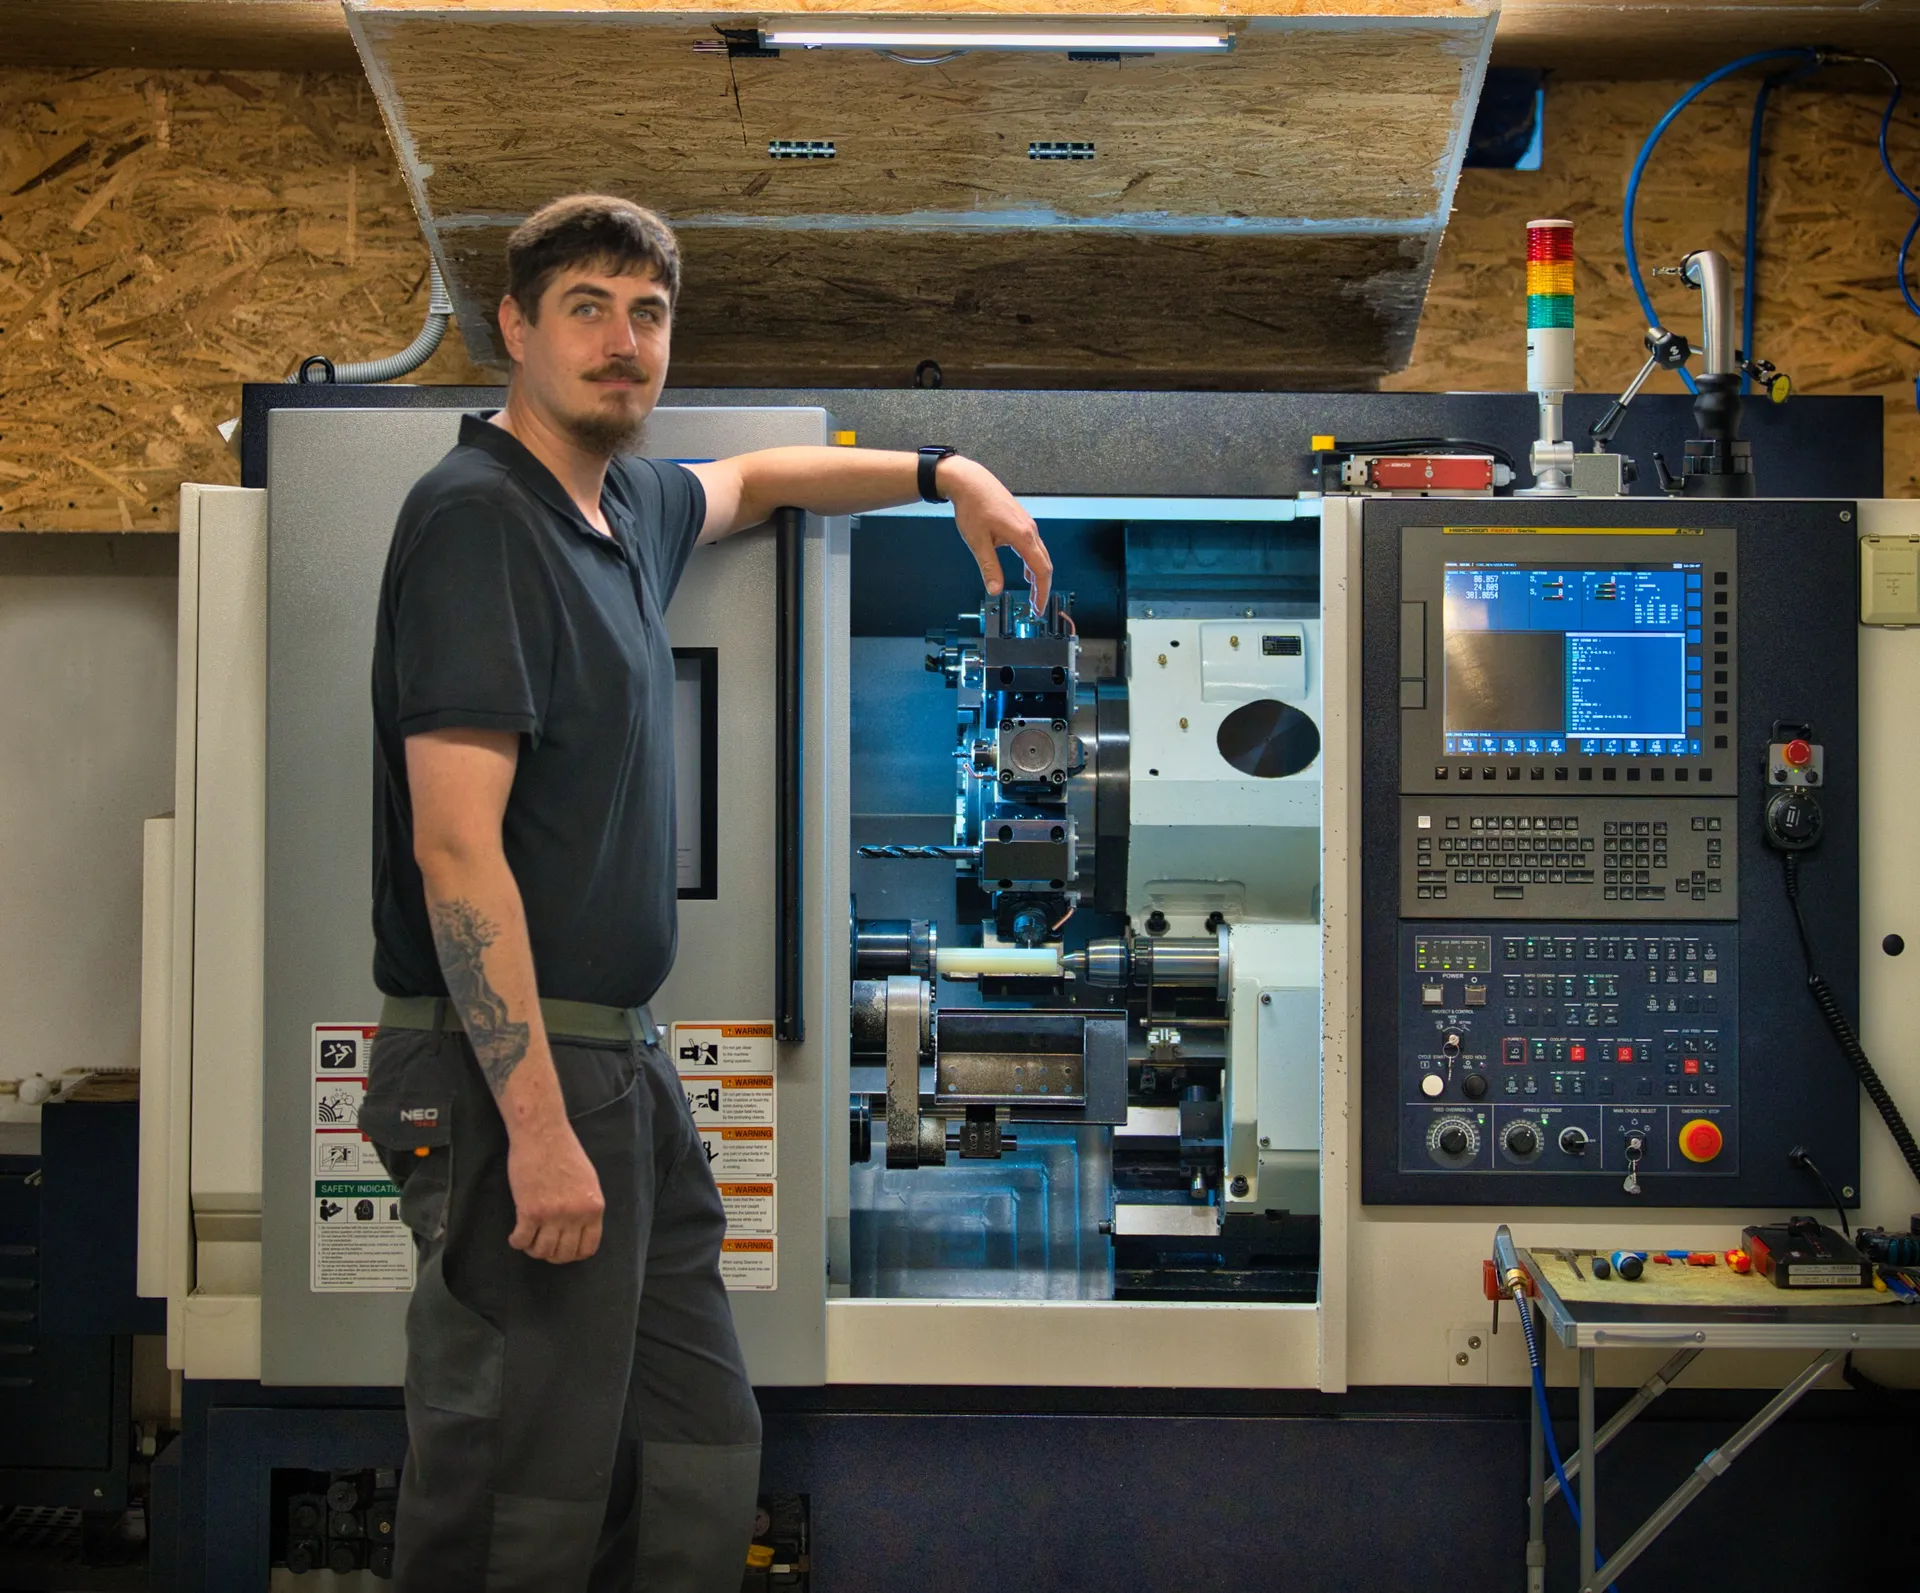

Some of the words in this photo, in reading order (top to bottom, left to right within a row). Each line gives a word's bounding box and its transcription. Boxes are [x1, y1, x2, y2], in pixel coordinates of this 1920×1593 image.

[735, 1027, 772, 1035] WARNING
[400, 1107, 439, 1122] NEO
[321, 1184, 355, 1193] SAFETY
